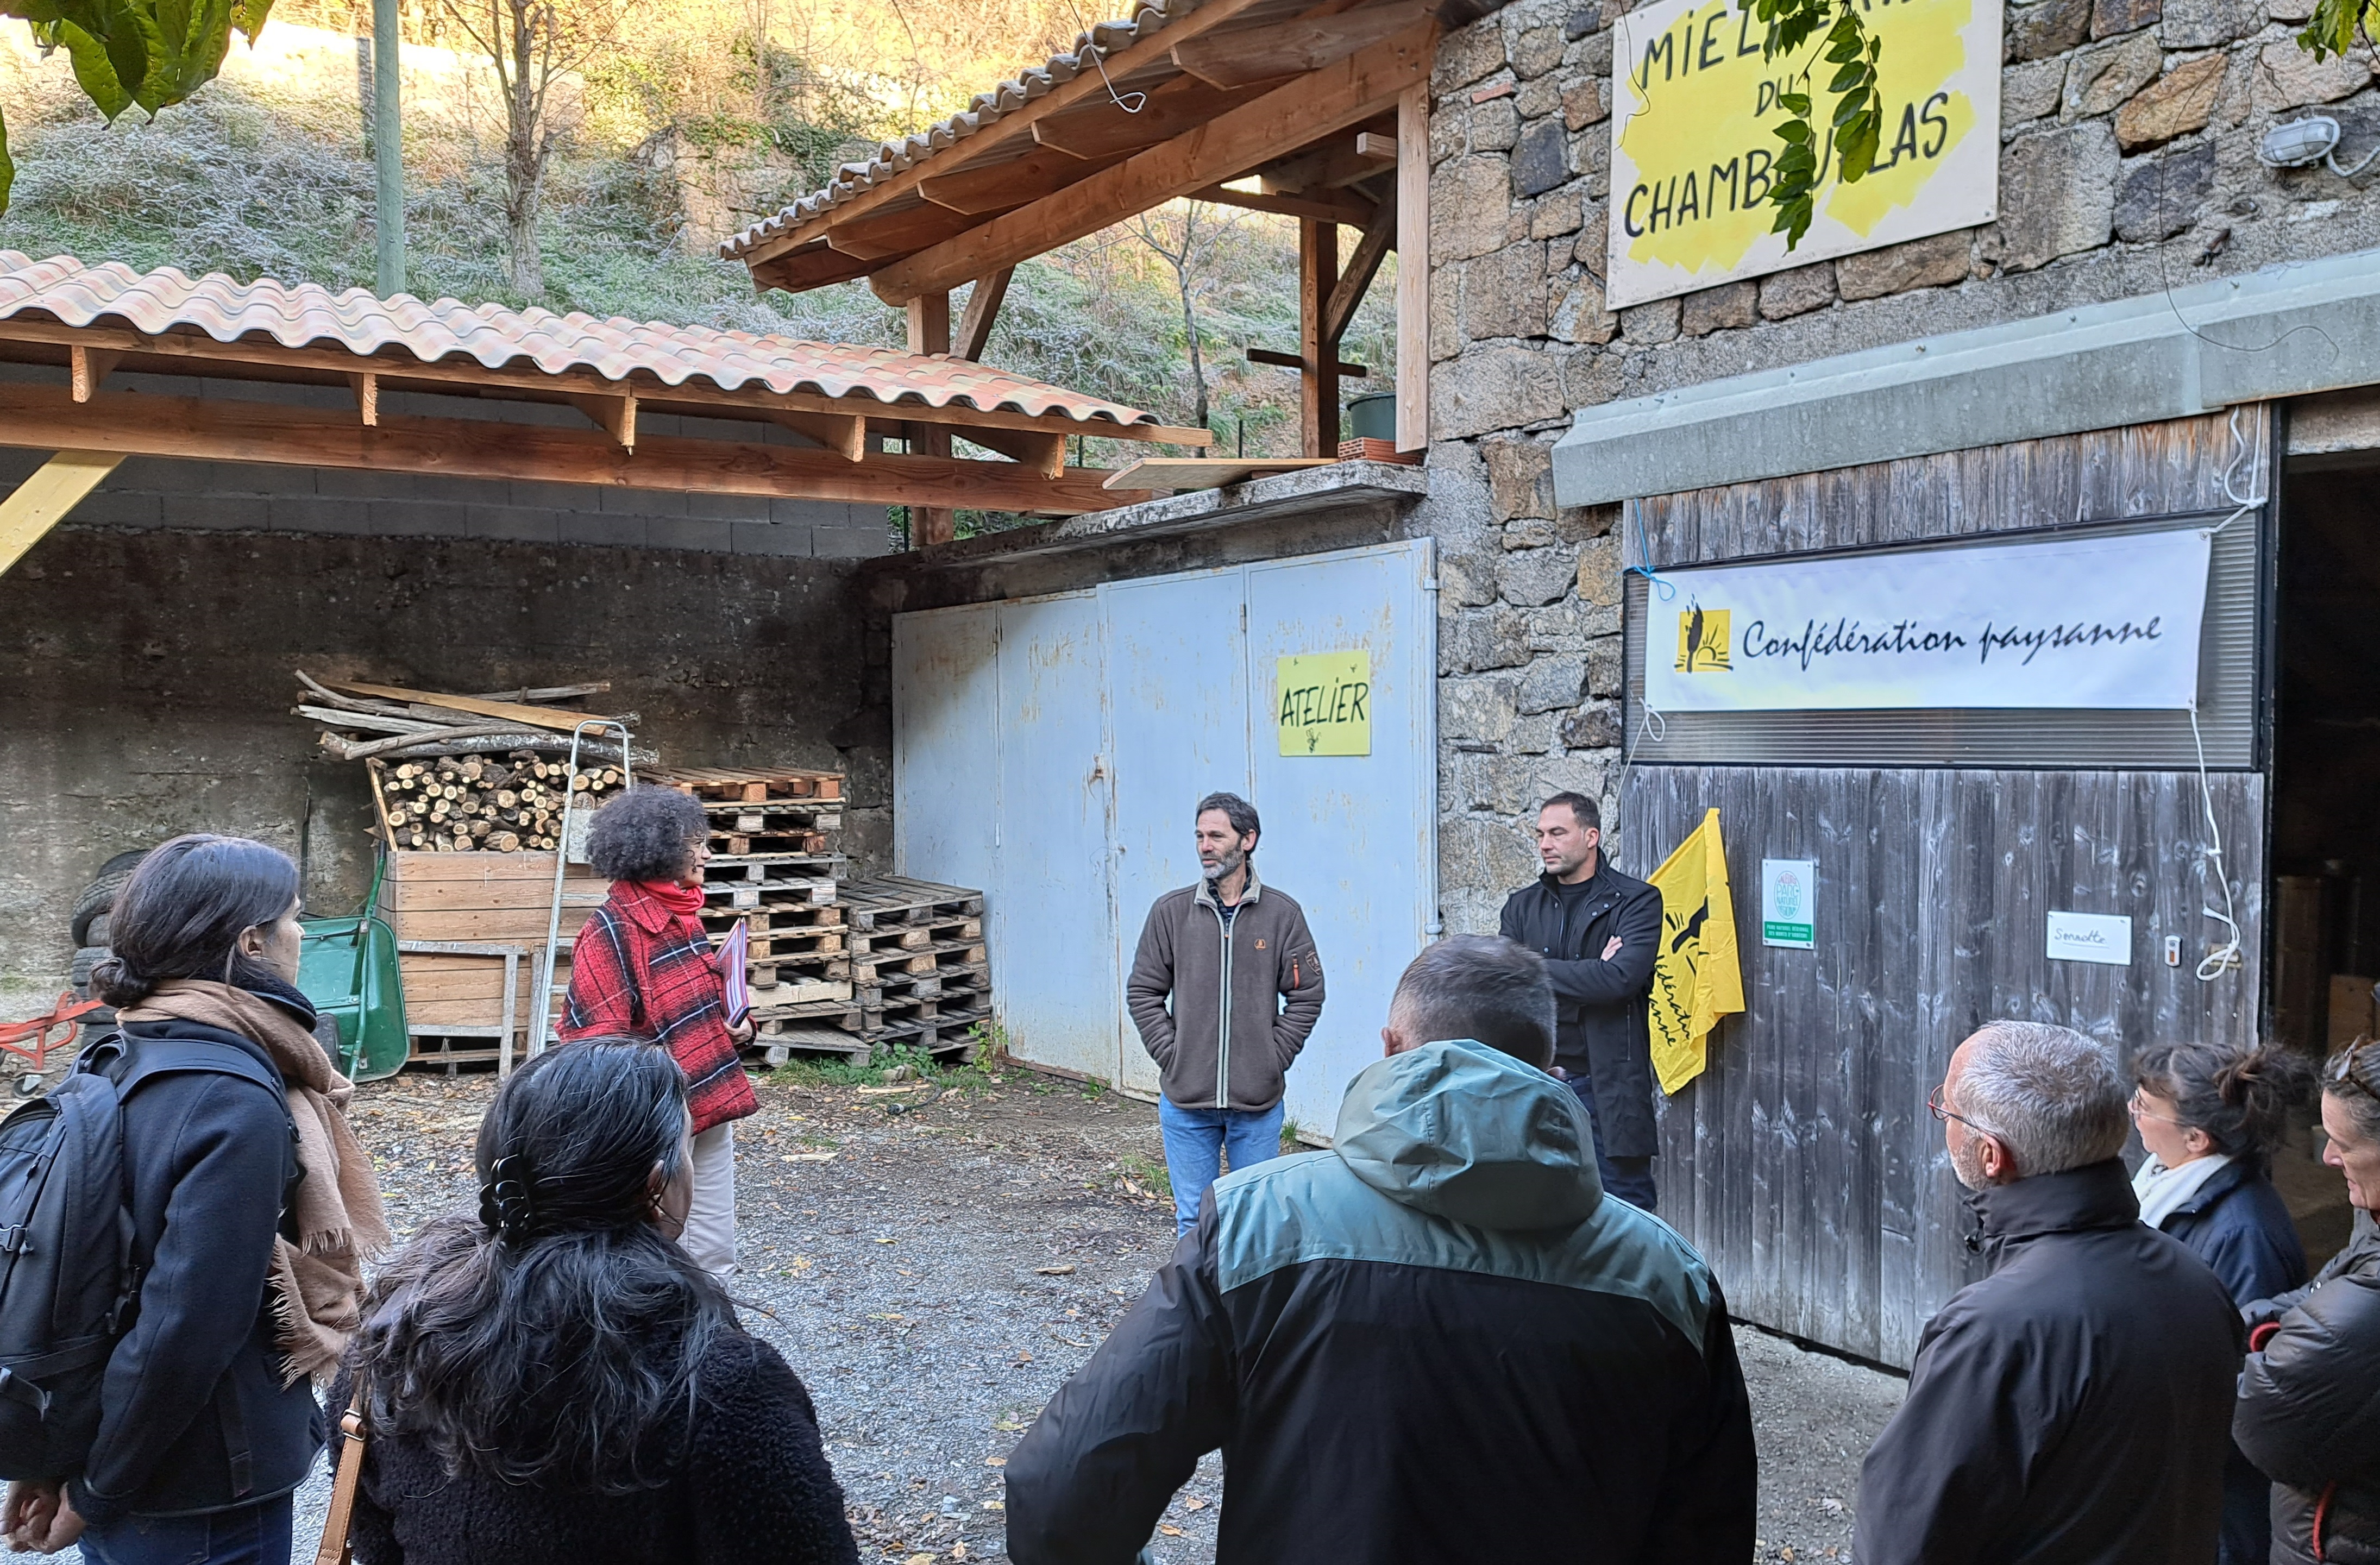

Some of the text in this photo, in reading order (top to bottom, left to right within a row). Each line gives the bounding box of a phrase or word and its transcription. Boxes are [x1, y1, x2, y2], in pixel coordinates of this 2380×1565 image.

[1754, 74, 1795, 117] DU
[1743, 615, 2162, 672] Confédération paysanne
[1776, 884, 1798, 897] PARC
